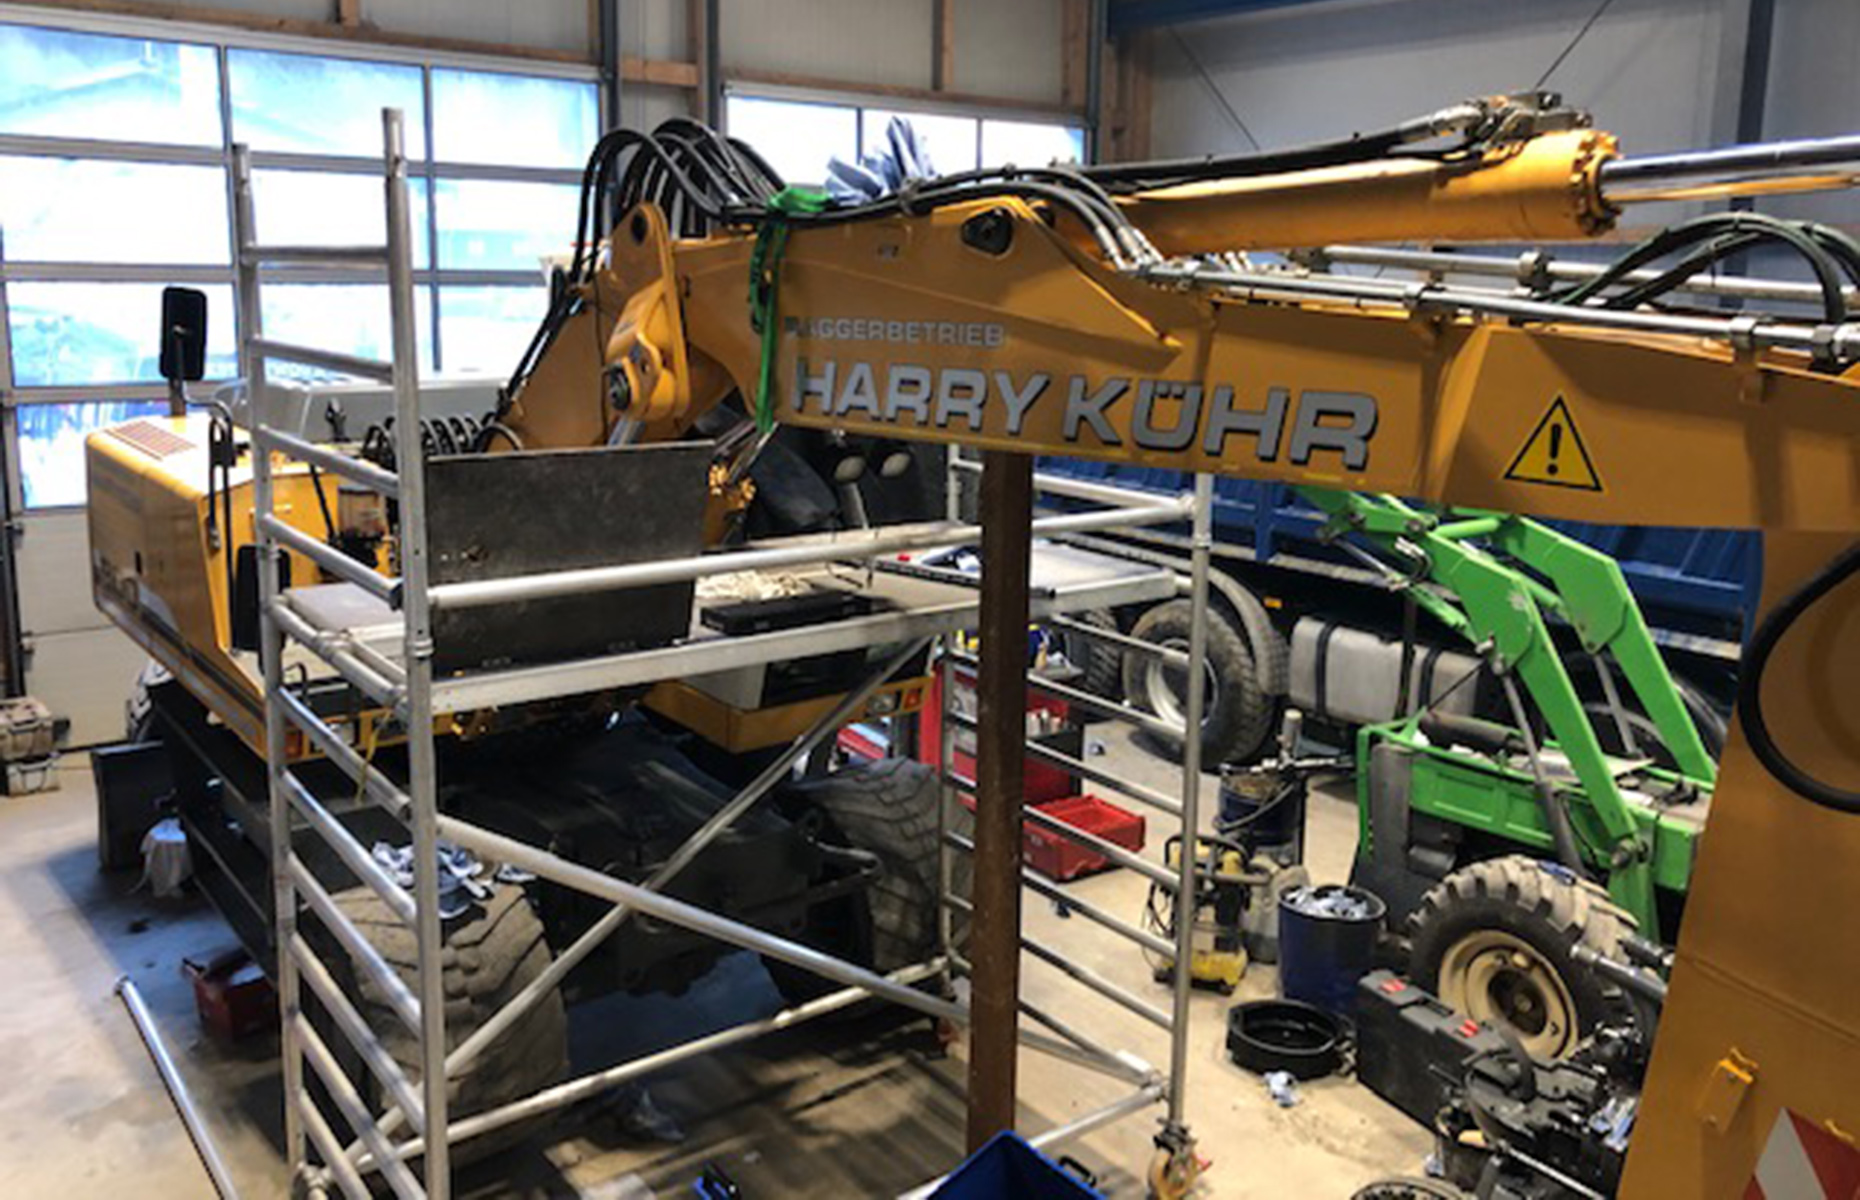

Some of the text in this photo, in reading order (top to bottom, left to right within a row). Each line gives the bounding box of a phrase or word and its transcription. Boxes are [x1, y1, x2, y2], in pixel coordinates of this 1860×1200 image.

[785, 316, 1005, 346] GGERBETRIEB
[792, 359, 1379, 471] HARRY KÜHR
